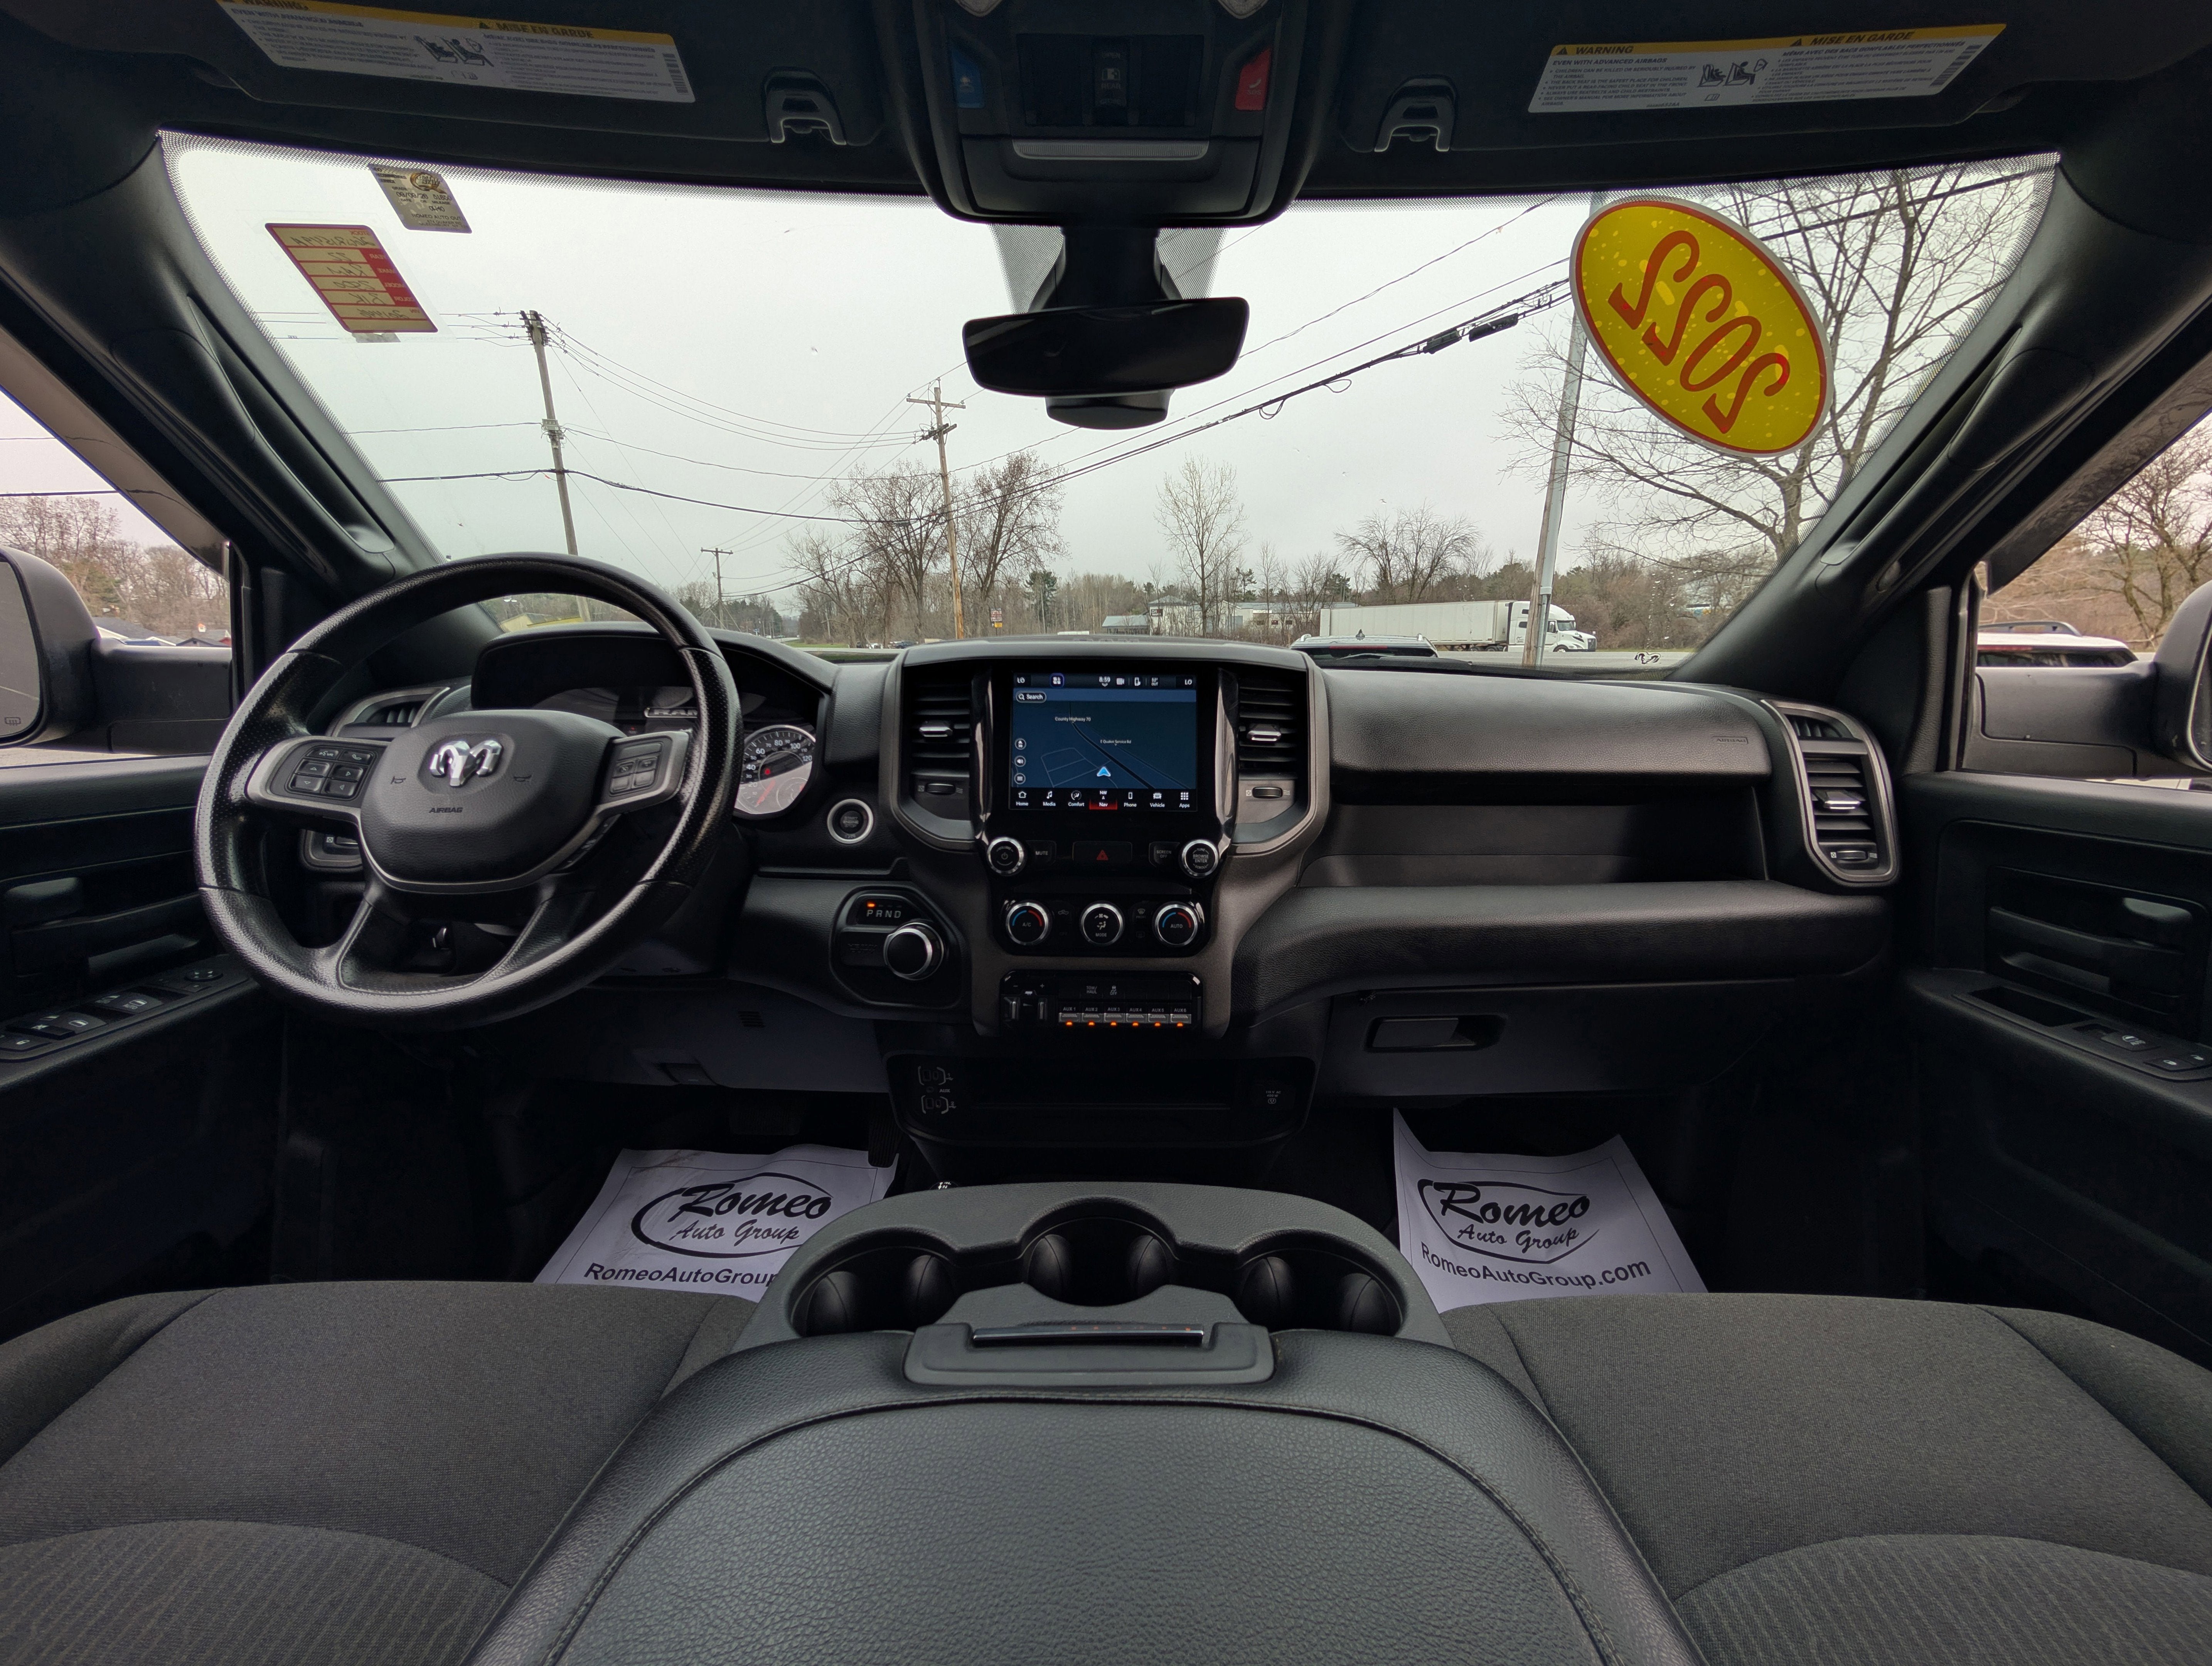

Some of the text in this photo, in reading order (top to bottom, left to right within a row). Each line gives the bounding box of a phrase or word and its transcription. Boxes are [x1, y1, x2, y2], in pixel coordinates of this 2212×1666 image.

[1576, 46, 1634, 55] WARNING
[1810, 32, 1915, 46] MISE EN GARDE
[668, 1183, 832, 1222] Romeo
[1433, 1182, 1590, 1228] Romeo
[669, 1219, 800, 1247] Auto Group
[1457, 1224, 1580, 1254] Auto Group
[1421, 1241, 1651, 1289] RomeoAutoGroup.com
